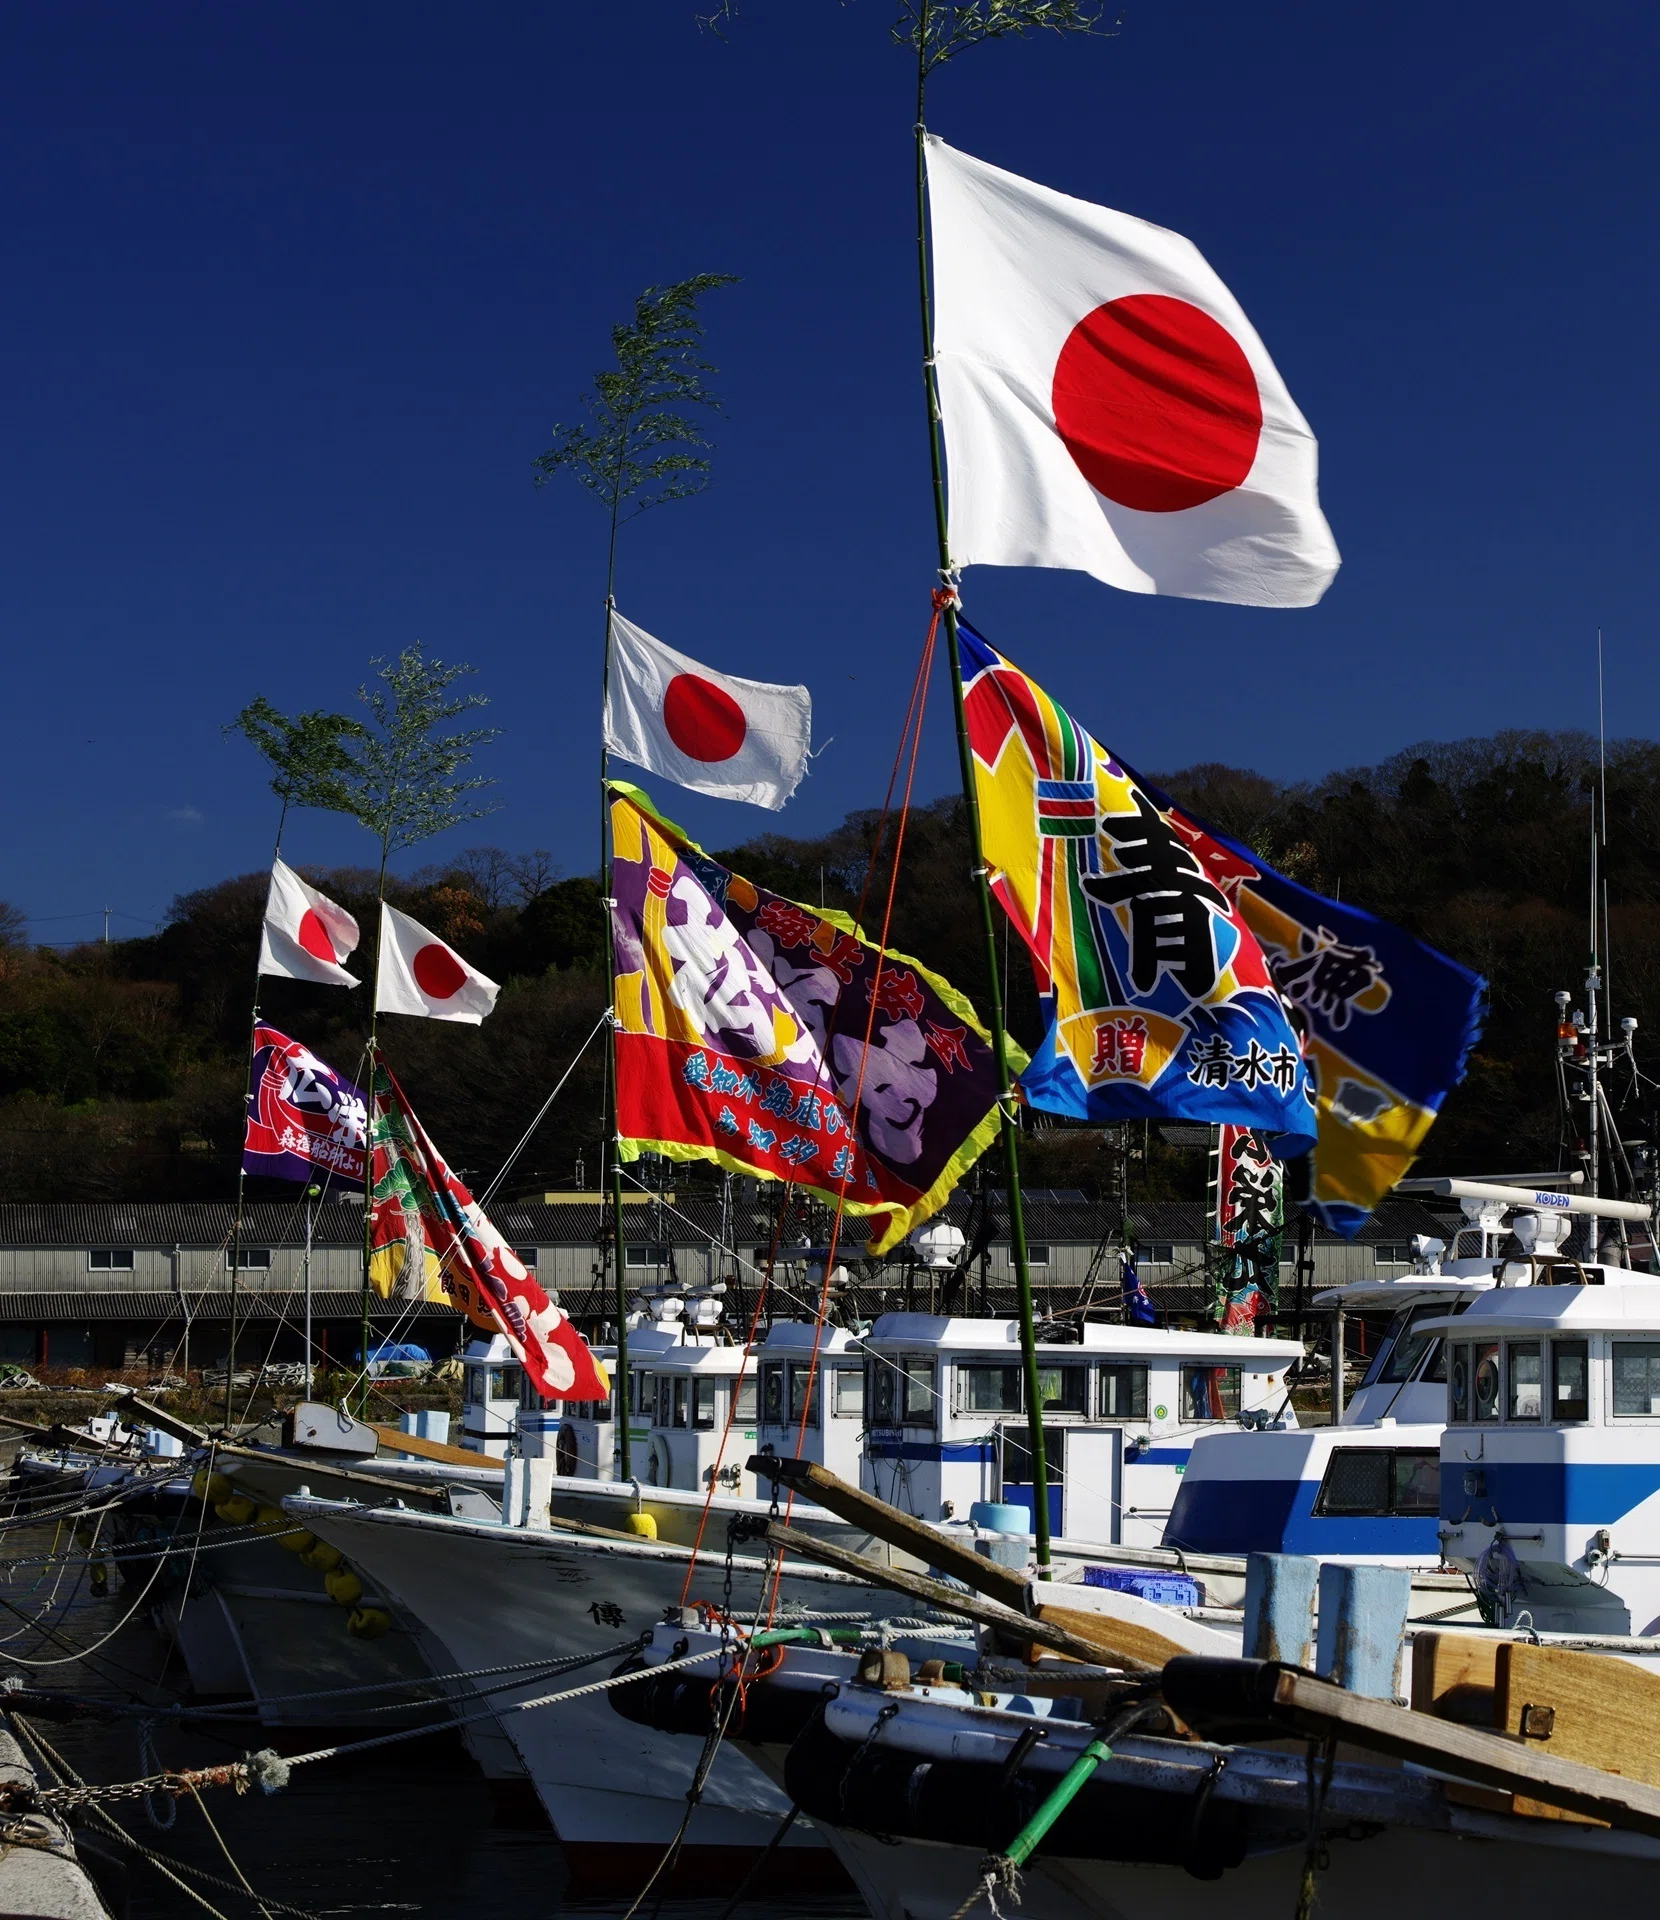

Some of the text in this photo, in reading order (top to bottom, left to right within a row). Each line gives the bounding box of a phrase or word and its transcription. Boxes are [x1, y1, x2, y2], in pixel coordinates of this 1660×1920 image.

[1082, 788, 1232, 1001] 青
[1090, 1016, 1147, 1076] 贈
[1187, 1034, 1298, 1099] 清水市
[278, 1126, 365, 1177] 森造船所より
[1535, 1191, 1570, 1208] KODEN
